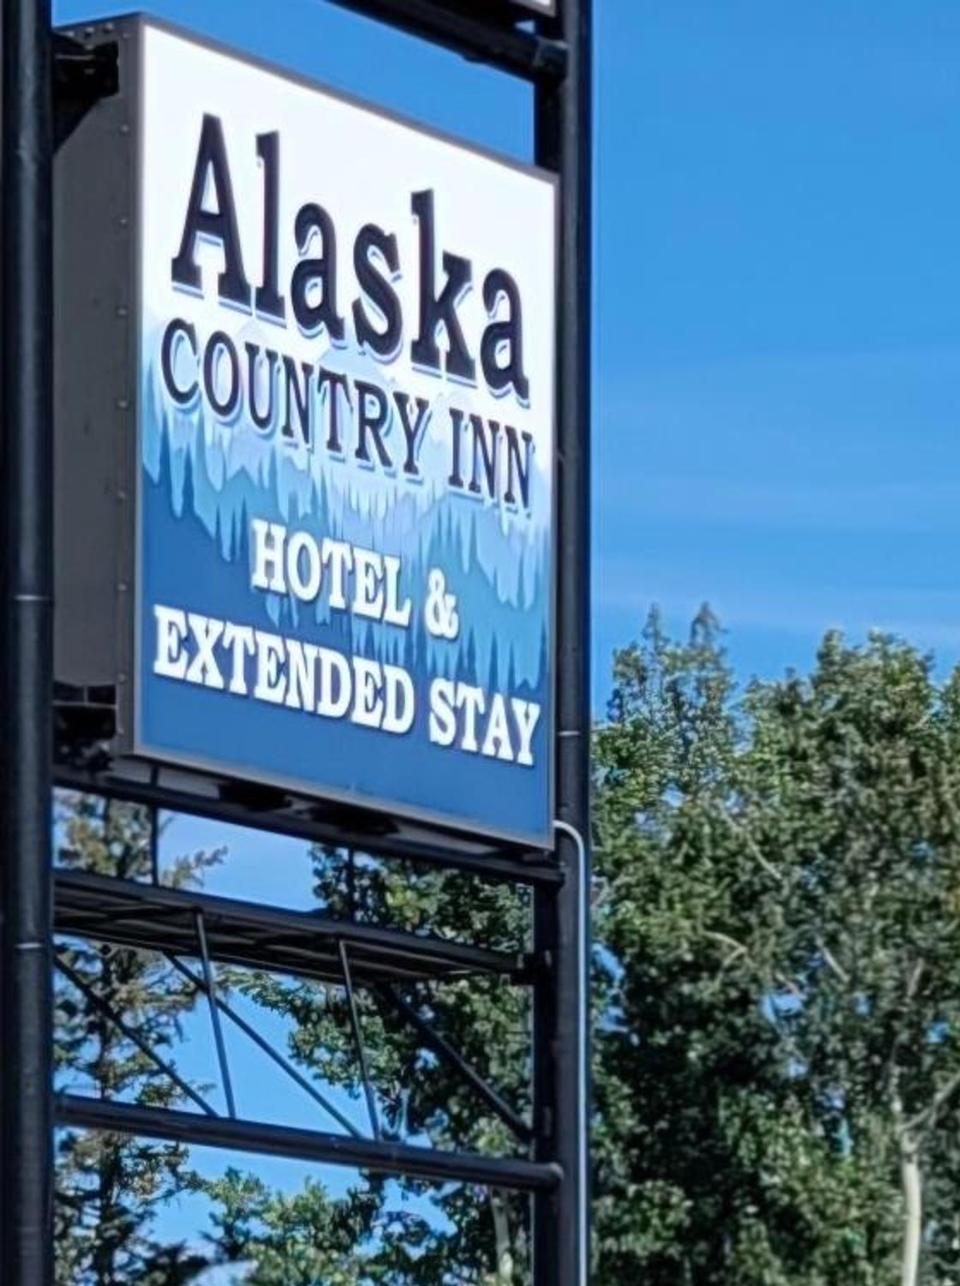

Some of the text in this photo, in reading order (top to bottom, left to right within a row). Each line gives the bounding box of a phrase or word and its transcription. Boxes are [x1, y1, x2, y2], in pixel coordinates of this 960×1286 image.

[171, 113, 531, 401] Alaska
[161, 319, 534, 509] COUNTRY INN
[251, 520, 459, 639] HOTEL &
[153, 605, 541, 766] EXTENDED STAY
